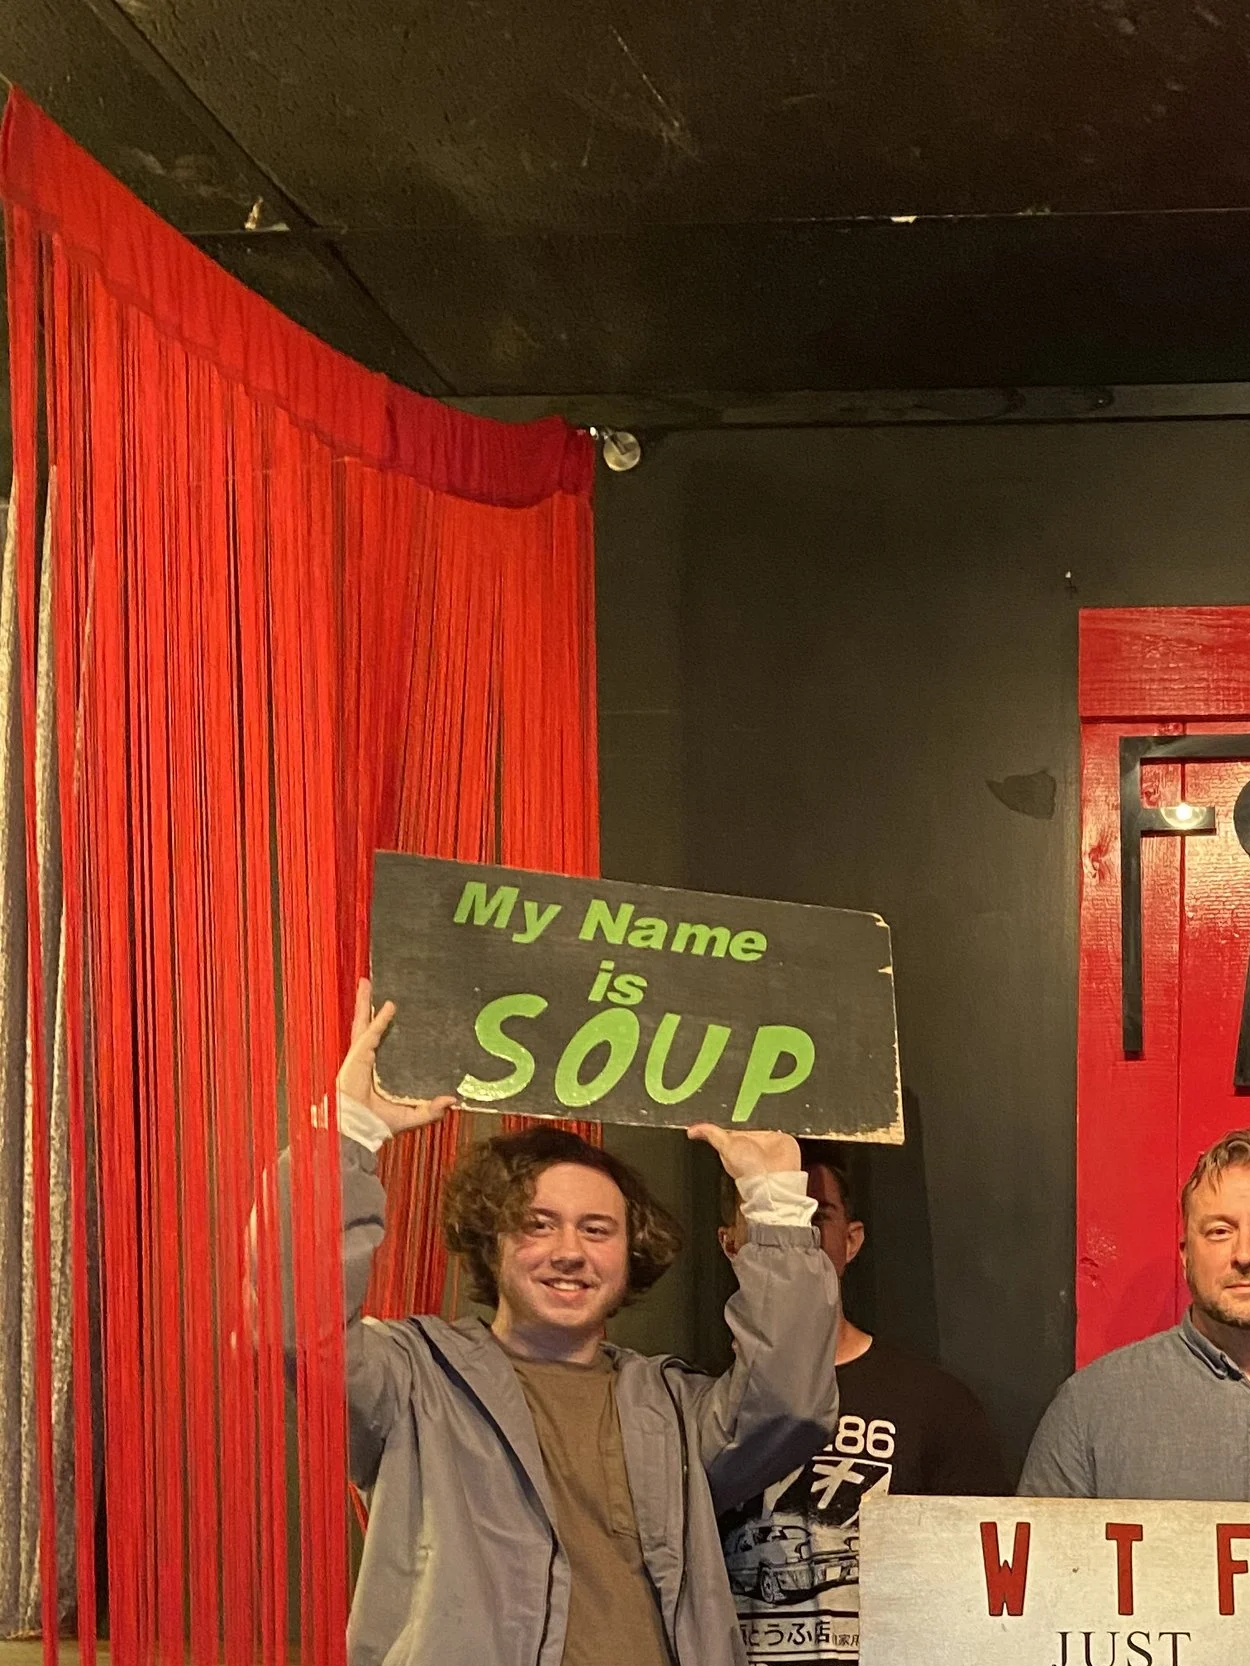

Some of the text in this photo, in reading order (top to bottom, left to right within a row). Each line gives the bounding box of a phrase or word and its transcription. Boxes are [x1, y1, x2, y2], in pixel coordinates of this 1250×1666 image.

[453, 881, 768, 962] My Name
[587, 959, 648, 1006] is
[456, 992, 816, 1123] SOUP
[741, 1621, 831, 1646] とうふ店
